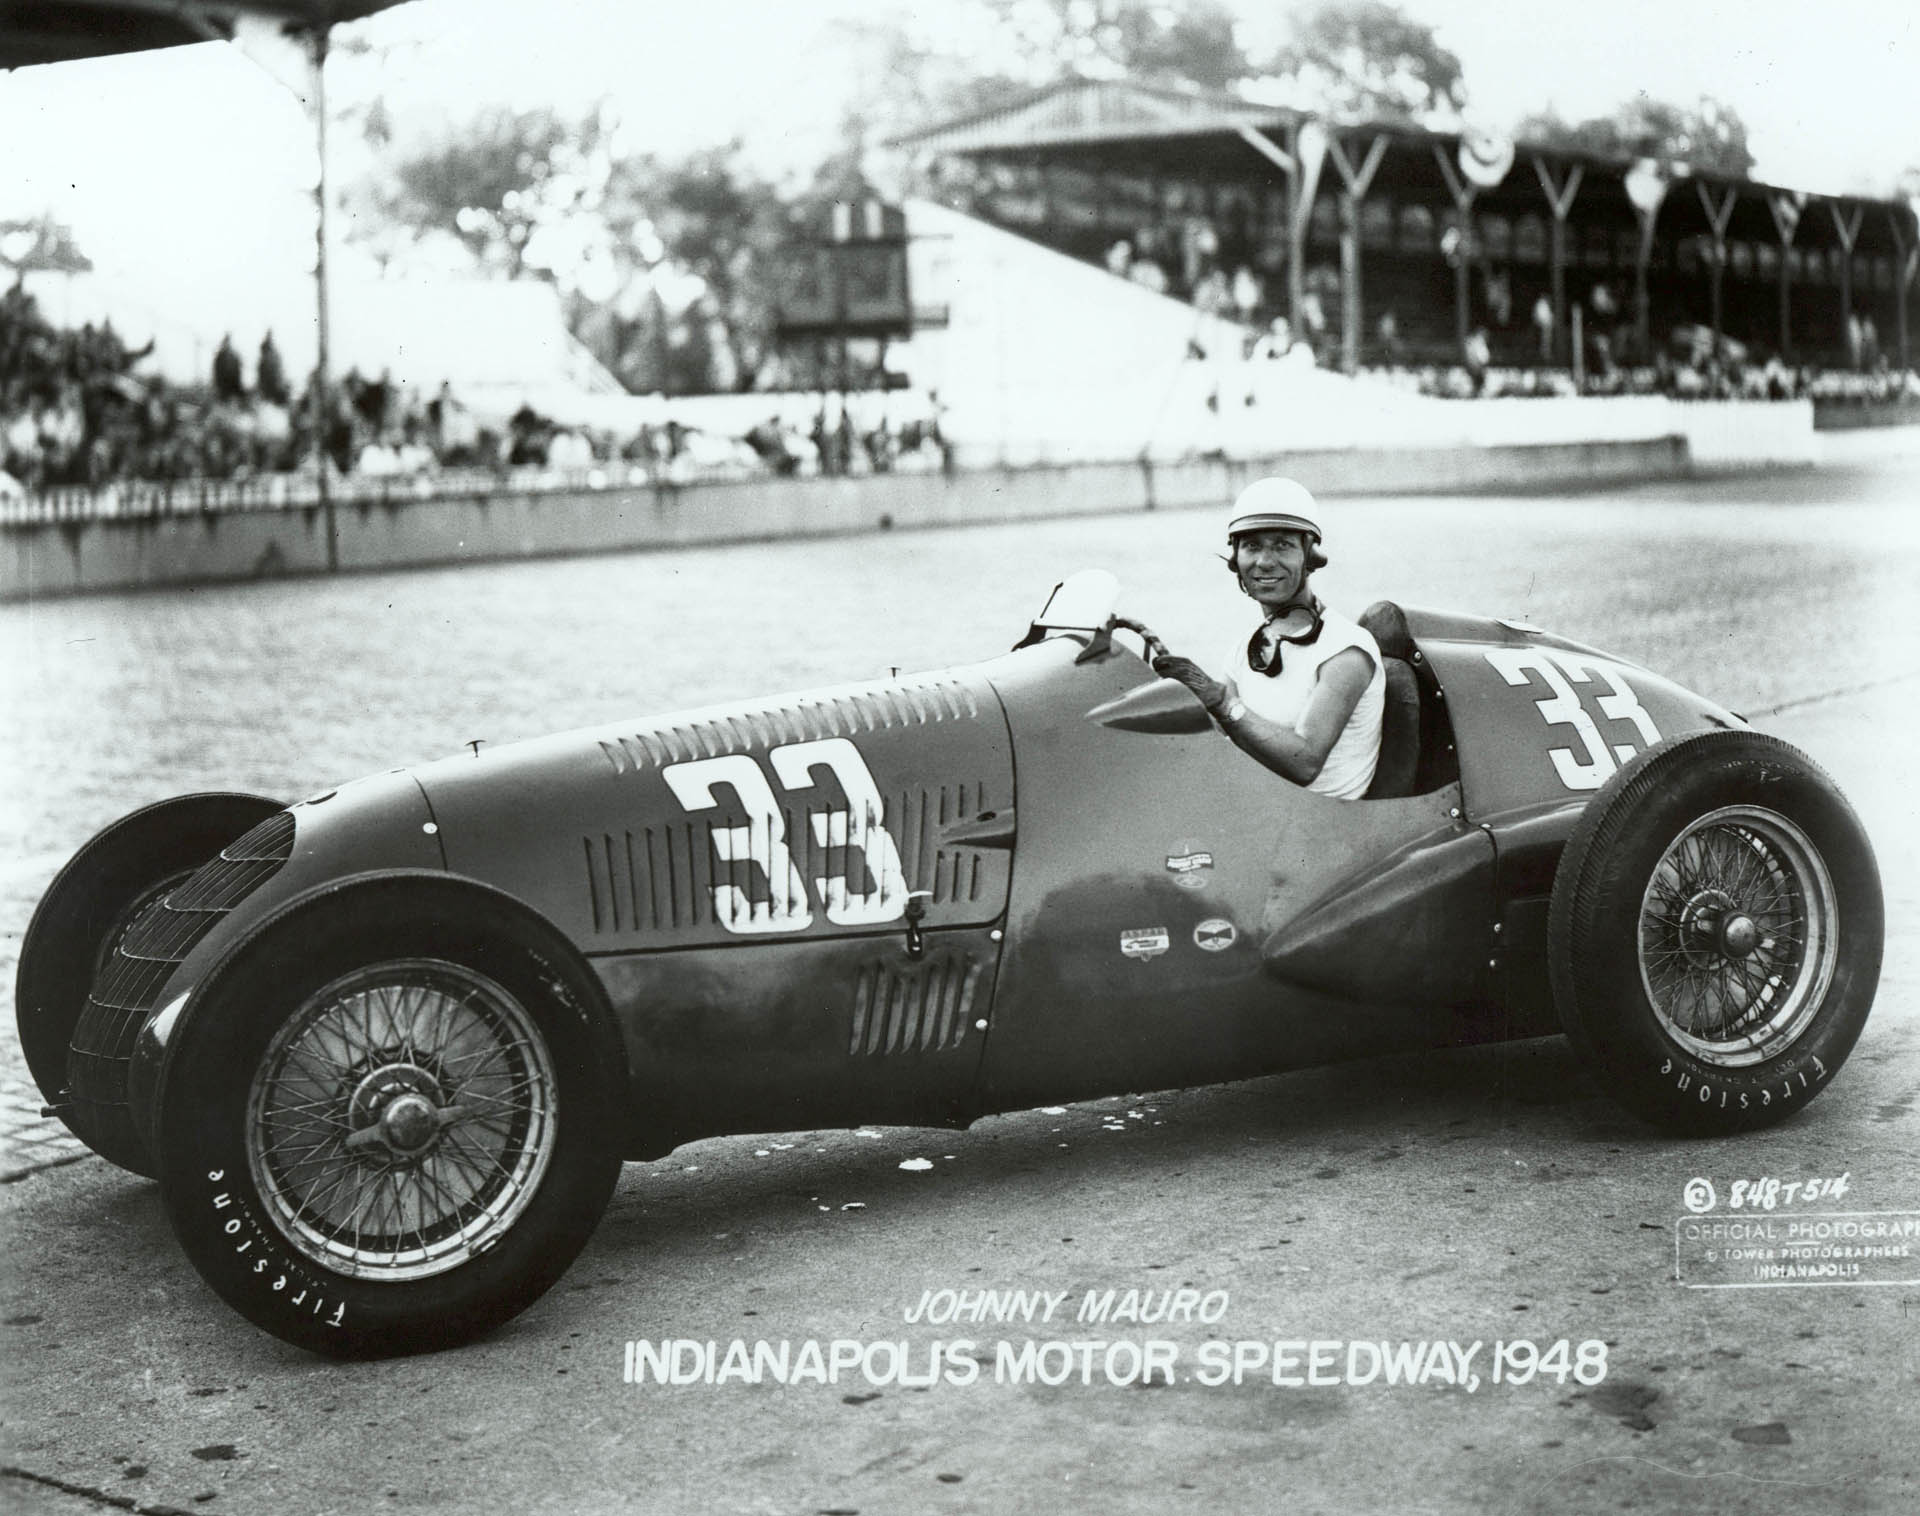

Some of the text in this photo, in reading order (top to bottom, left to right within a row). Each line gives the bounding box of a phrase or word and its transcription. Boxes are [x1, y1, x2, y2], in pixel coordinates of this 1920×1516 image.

[1484, 647, 1663, 790] 33
[662, 737, 909, 935] 33
[1661, 1055, 1827, 1109] Firestone
[208, 1169, 345, 1327] Firestone
